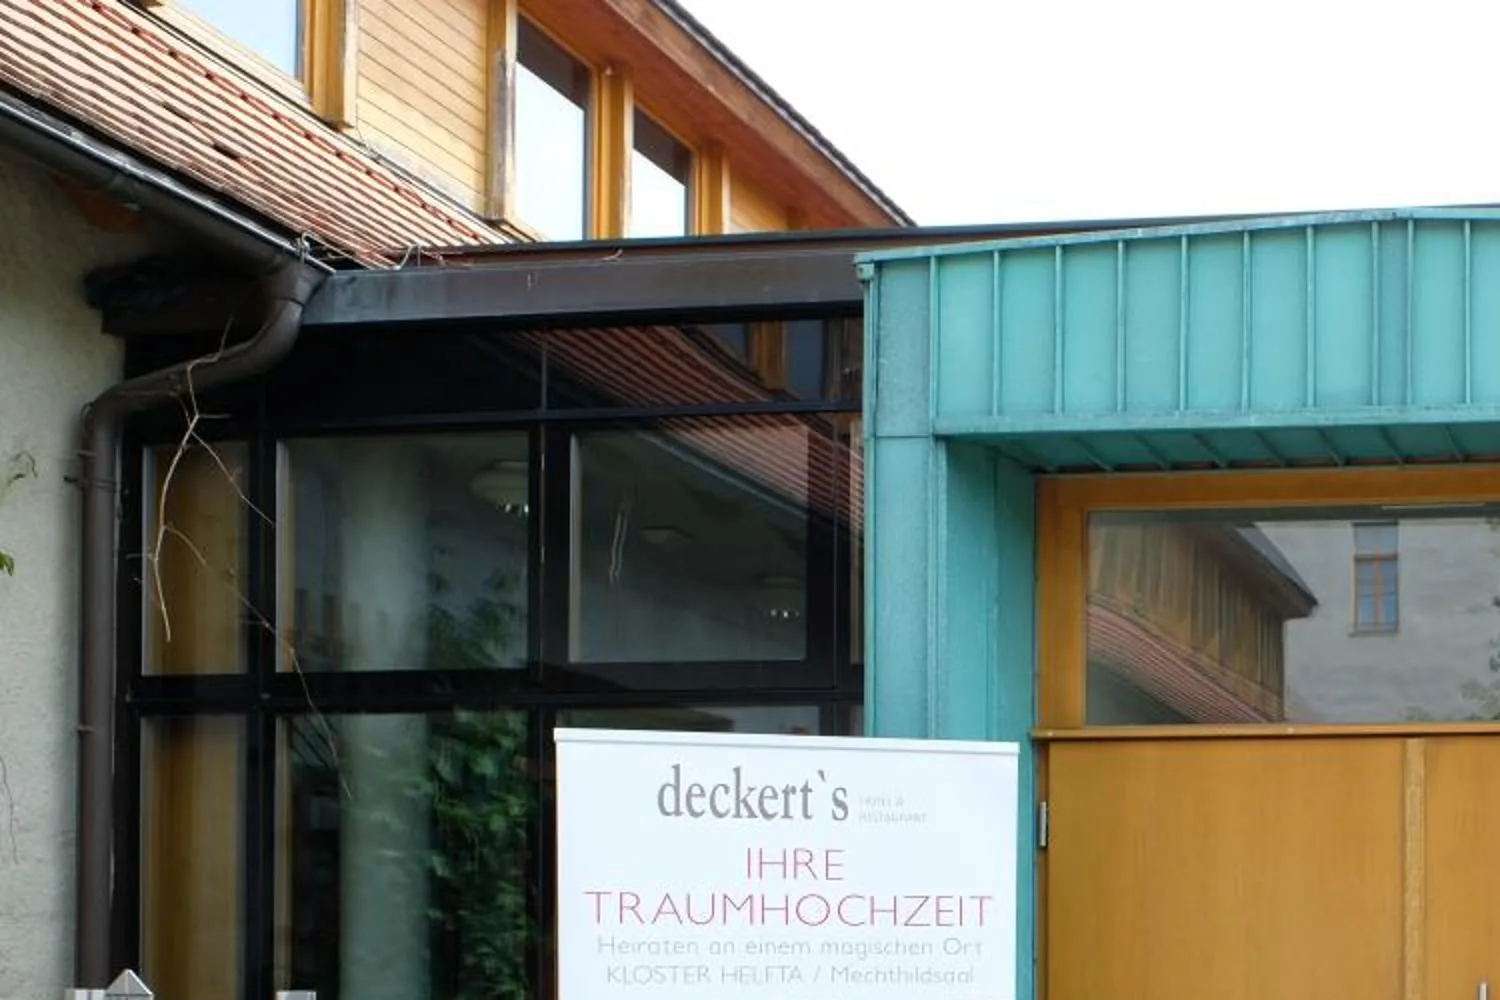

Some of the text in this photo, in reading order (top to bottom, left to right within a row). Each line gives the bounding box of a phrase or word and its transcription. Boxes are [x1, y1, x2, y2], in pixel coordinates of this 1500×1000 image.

[746, 847, 844, 881] IHRE
[584, 891, 993, 927] TRAUMHOCHZEIT
[597, 937, 983, 961] Heiraten an einem magischen Ort
[607, 966, 711, 985] KLOSTER
[721, 966, 803, 984] HELFTA
[831, 965, 974, 985] Mechthildsaal
